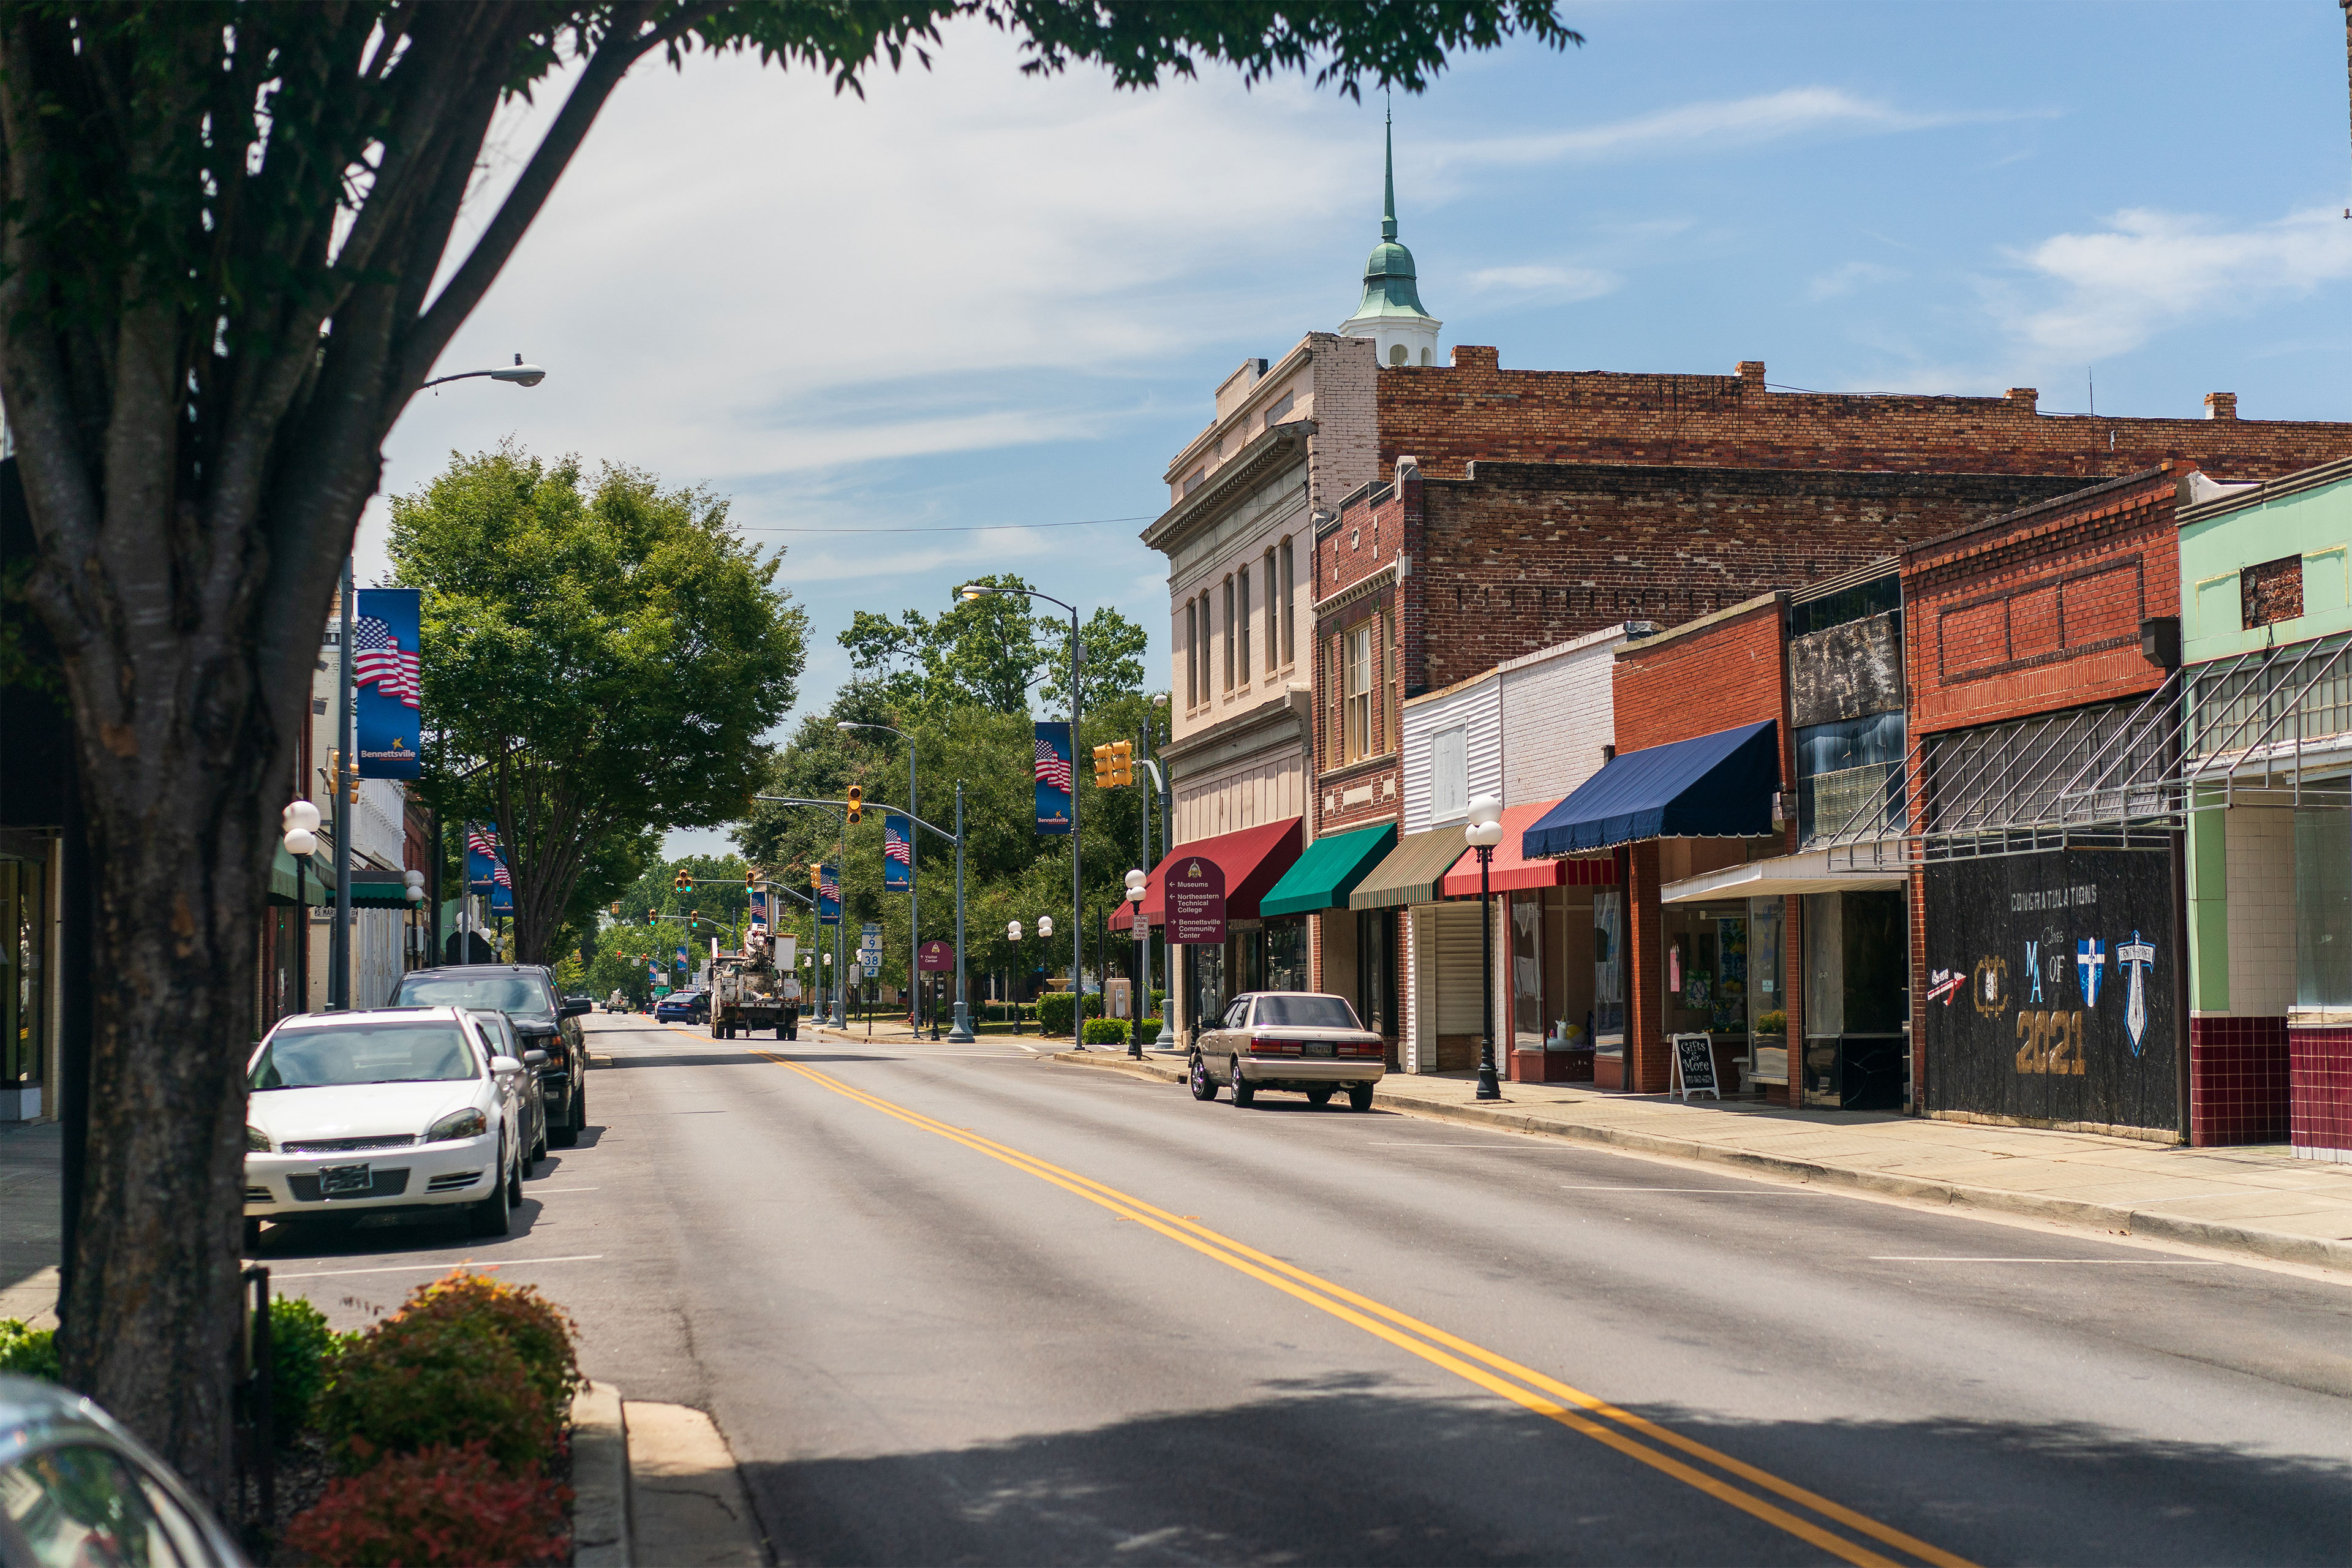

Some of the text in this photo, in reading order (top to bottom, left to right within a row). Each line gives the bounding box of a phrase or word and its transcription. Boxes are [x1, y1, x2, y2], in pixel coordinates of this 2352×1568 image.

[2011, 884, 2097, 912] CONGRATULATIONS
[2041, 925, 2064, 947] Class
[869, 939, 875, 948] 9
[864, 956, 878, 965] 38
[2049, 955, 2065, 982] OF
[1681, 1041, 1706, 1054] Gifts
[2016, 1011, 2085, 1075] 2021
[1691, 1051, 1700, 1061] &
[1683, 1058, 1709, 1072] More
